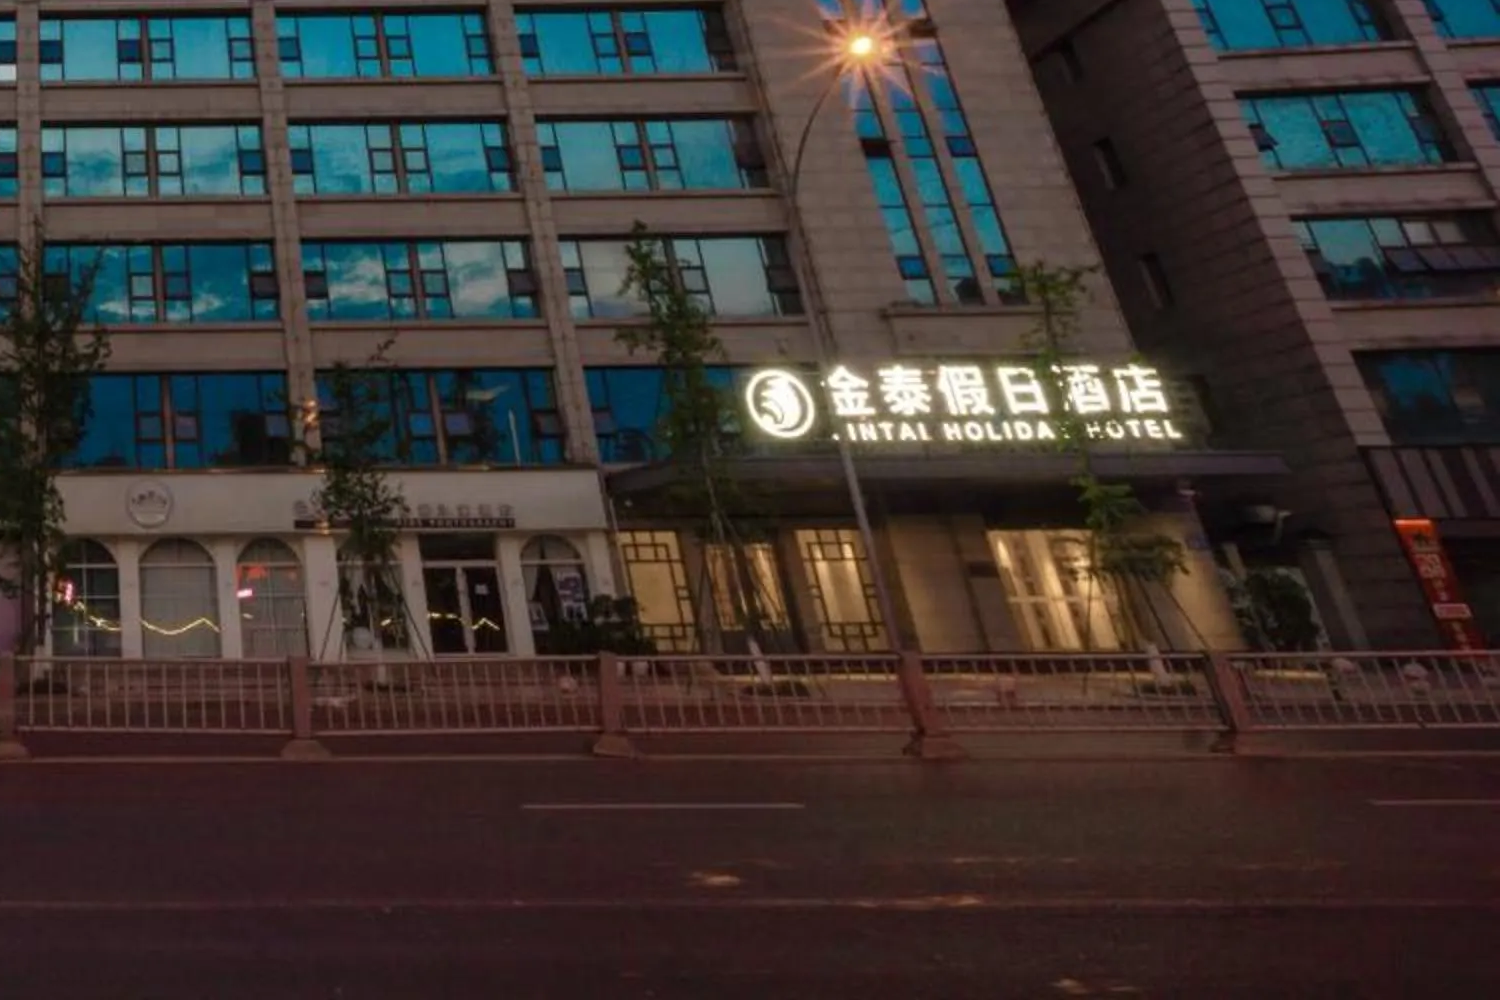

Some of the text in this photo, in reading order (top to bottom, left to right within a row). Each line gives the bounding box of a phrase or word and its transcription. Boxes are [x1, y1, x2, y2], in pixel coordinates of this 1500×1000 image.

[821, 364, 1168, 416] 金泰假日酒店
[833, 418, 1182, 441] INTAI HOLIDA HOTEL
